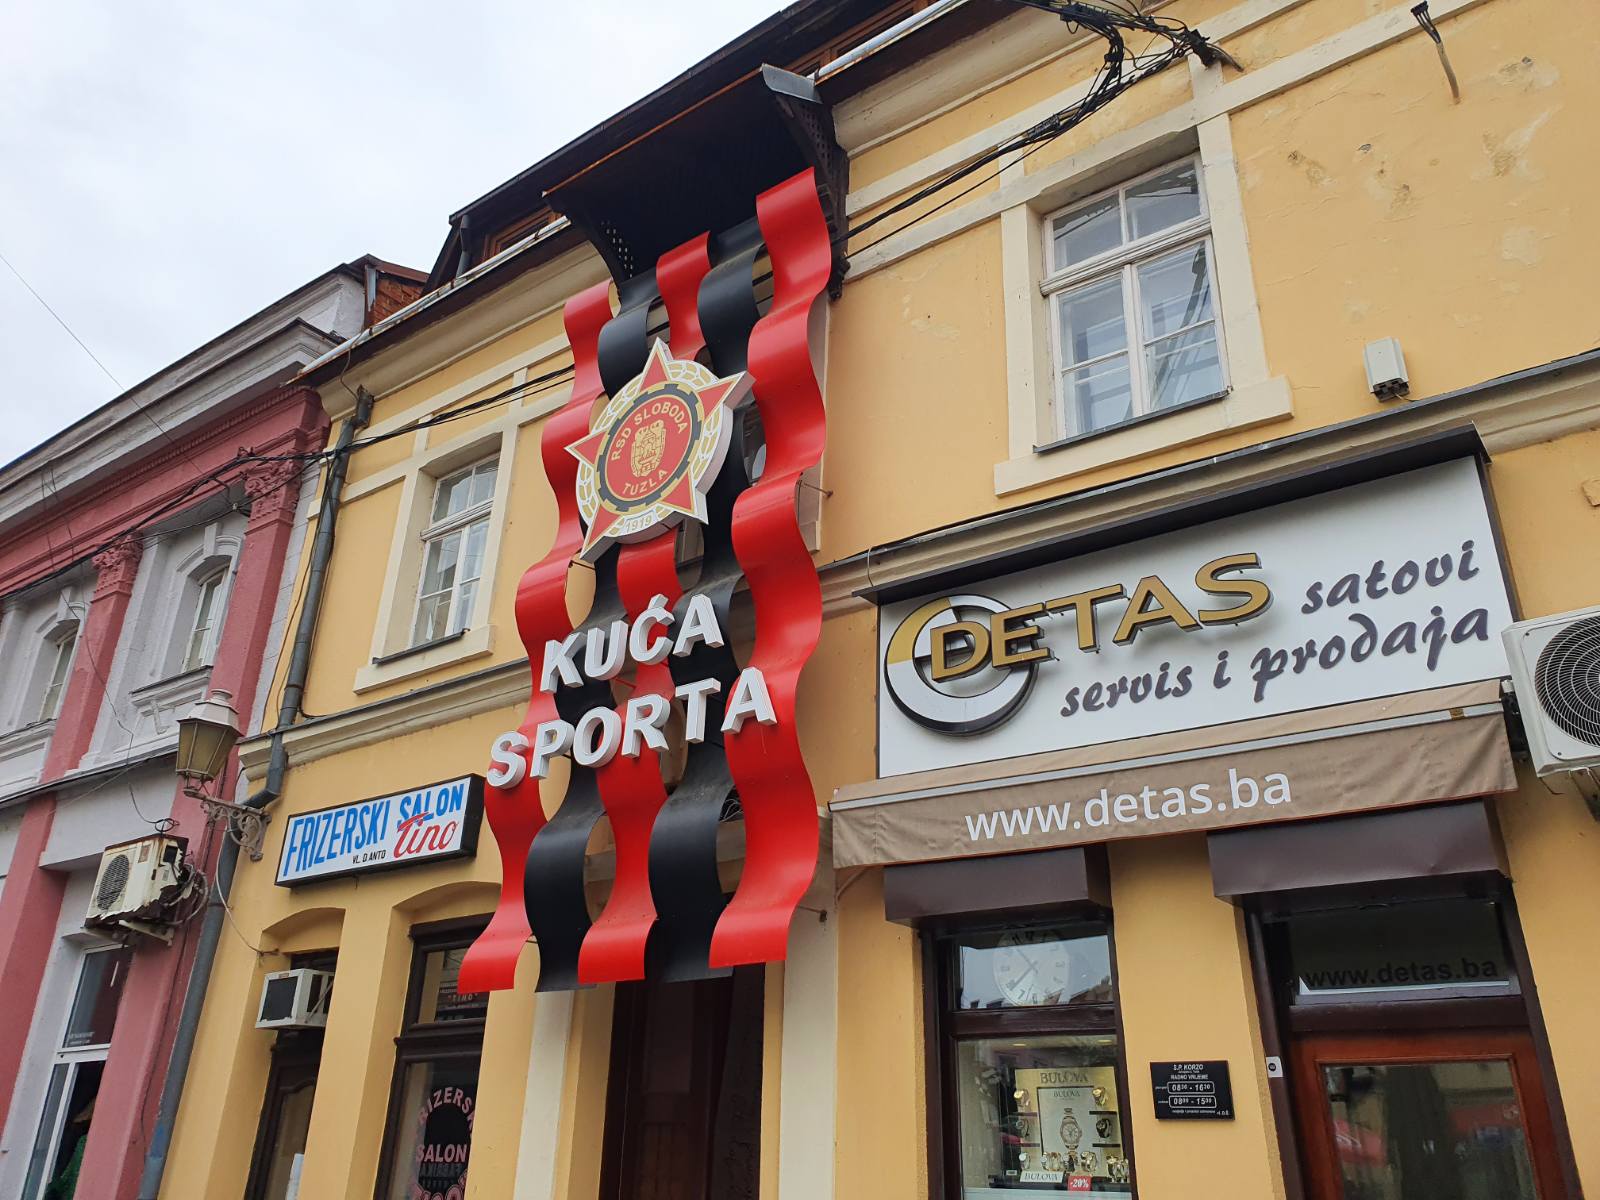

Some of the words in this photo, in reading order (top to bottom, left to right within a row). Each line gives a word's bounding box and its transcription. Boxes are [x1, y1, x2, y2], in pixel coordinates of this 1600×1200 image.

[611, 427, 631, 461] RSD
[634, 401, 689, 434] SLOBODA
[622, 469, 668, 496] TUZLA
[625, 515, 652, 532] 1919
[929, 552, 1274, 683] DETAS
[1301, 540, 1480, 615] satovi
[540, 594, 724, 693] KUĆA
[1060, 661, 1193, 718] servis
[1213, 650, 1231, 690] i
[1250, 604, 1490, 703] prodaja
[486, 666, 778, 789] SPORTA
[965, 768, 1293, 841] www.detas.ba
[283, 799, 391, 877] FRIZERSKI
[397, 783, 464, 831] SALON
[394, 811, 459, 858] Tino
[1306, 957, 1497, 987] www.detas.ba
[1040, 1071, 1088, 1084] BULOVA
[416, 1143, 467, 1163] SALON
[1024, 1172, 1058, 1181] BULOVA
[1070, 1178, 1089, 1188] -20%
